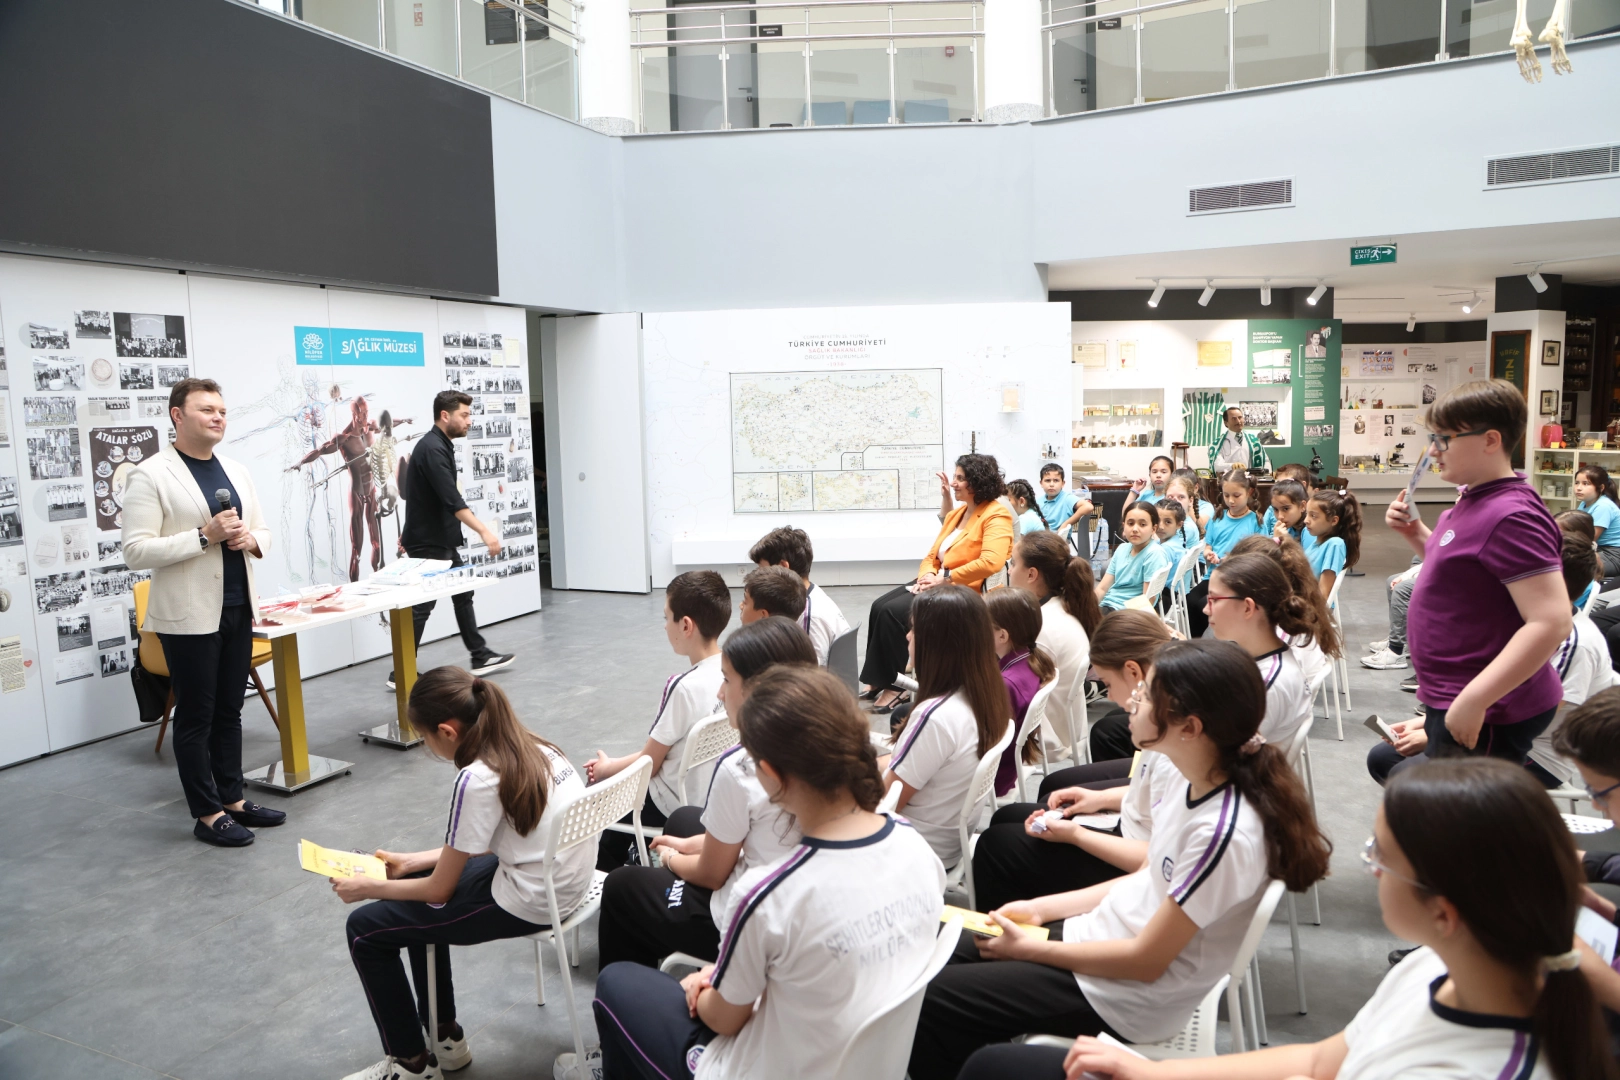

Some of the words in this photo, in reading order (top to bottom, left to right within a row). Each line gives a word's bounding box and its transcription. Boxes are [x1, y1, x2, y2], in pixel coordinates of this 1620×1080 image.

[384, 340, 417, 353] MÜZESİ
[788, 340, 825, 348] TÜRKİYE
[828, 338, 886, 347] CUMHURİYETİ
[95, 431, 128, 444] ATALAR
[131, 429, 153, 444] SÖZÜ
